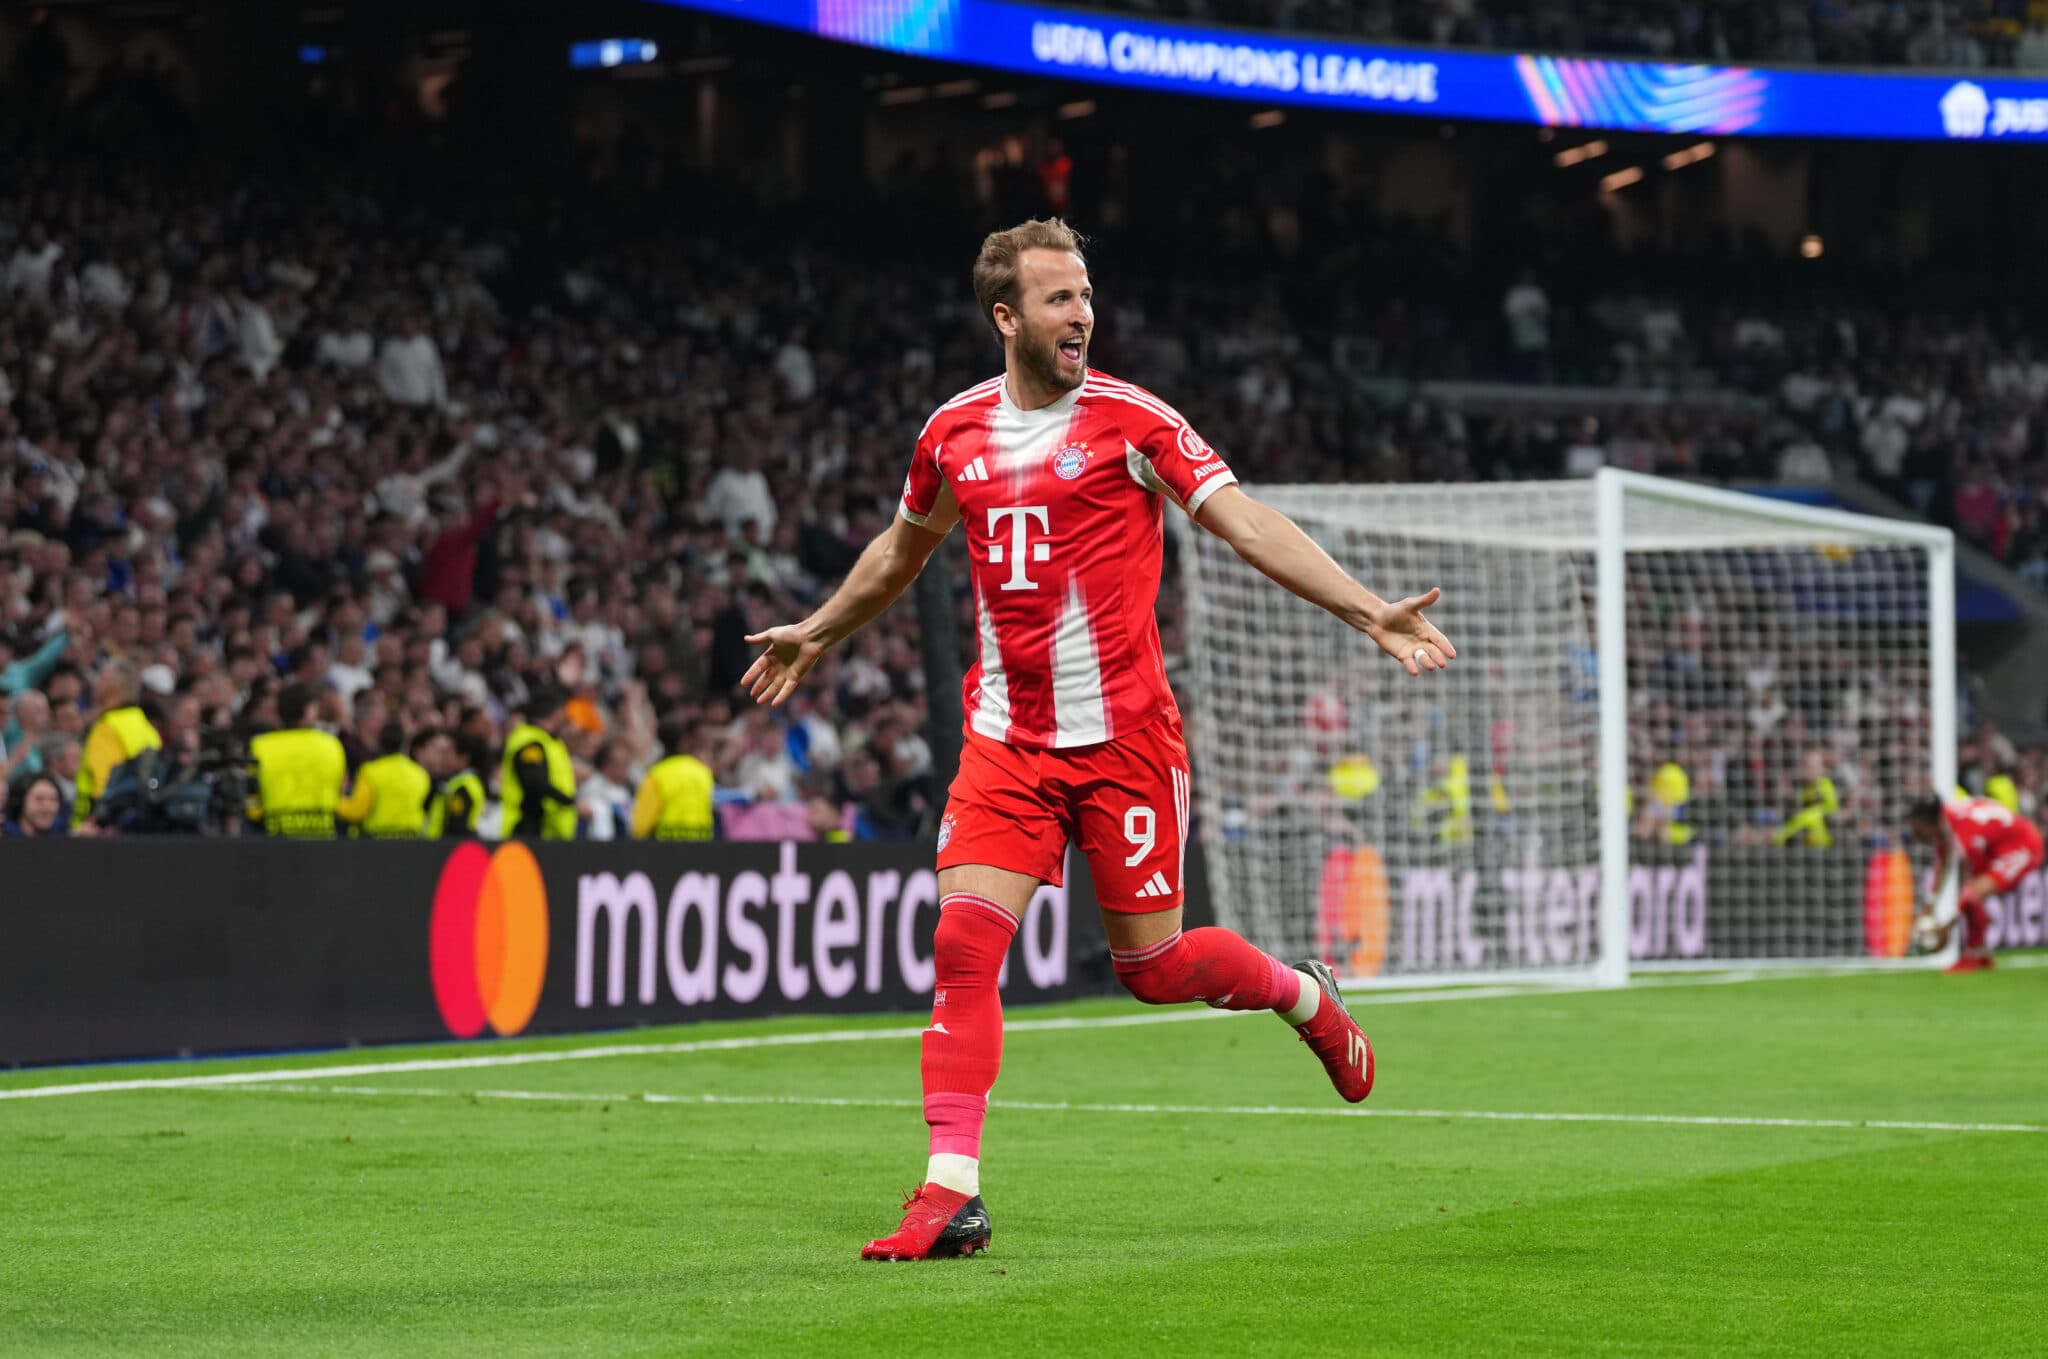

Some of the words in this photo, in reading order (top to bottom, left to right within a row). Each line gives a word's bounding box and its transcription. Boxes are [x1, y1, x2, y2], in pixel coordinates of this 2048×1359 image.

[1031, 20, 1106, 70] UEFA
[1109, 30, 1300, 92] CHAMPIONS
[1302, 52, 1439, 103] LEAGUE
[1192, 460, 1227, 481] Allian
[1124, 805, 1156, 867] 9
[575, 839, 1070, 1008] mastercd
